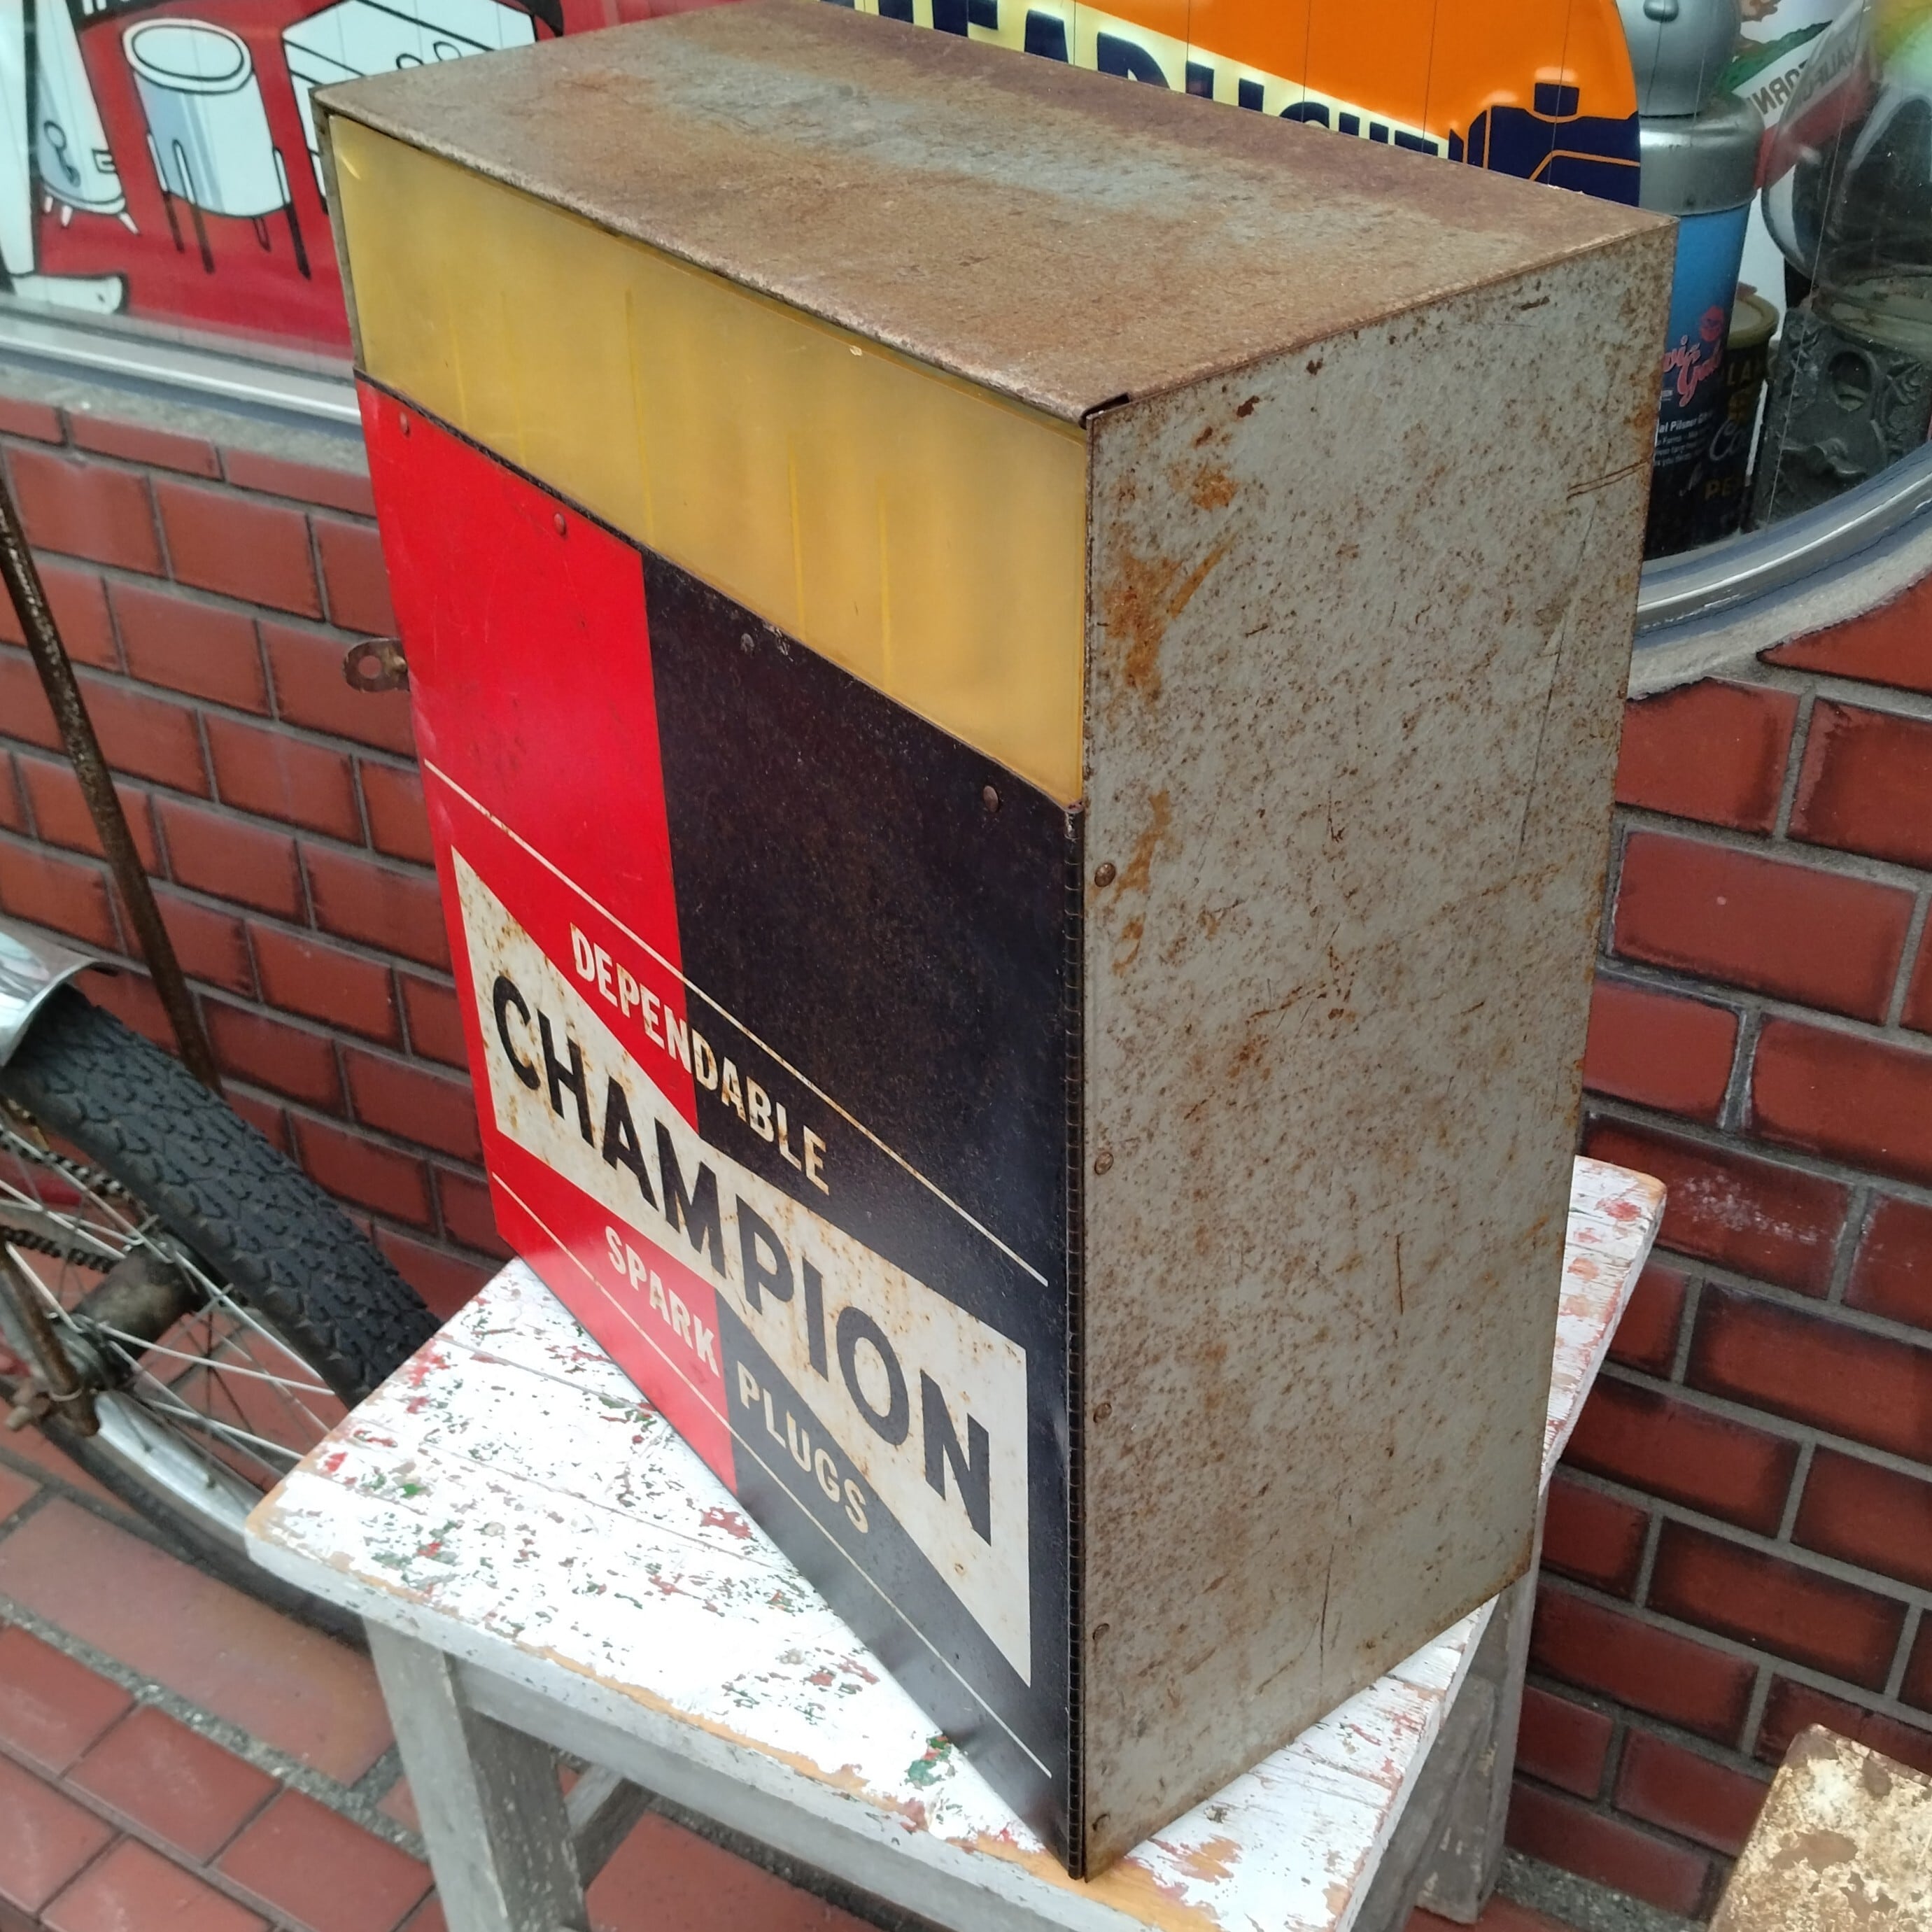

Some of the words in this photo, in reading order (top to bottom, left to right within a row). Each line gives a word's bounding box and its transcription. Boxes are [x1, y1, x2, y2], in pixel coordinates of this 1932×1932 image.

[570, 922, 831, 1195] DEPENDABLE
[493, 974, 992, 1547] CHAMPION
[605, 1225, 721, 1378] SPARK
[736, 1360, 870, 1535] PLUGS
